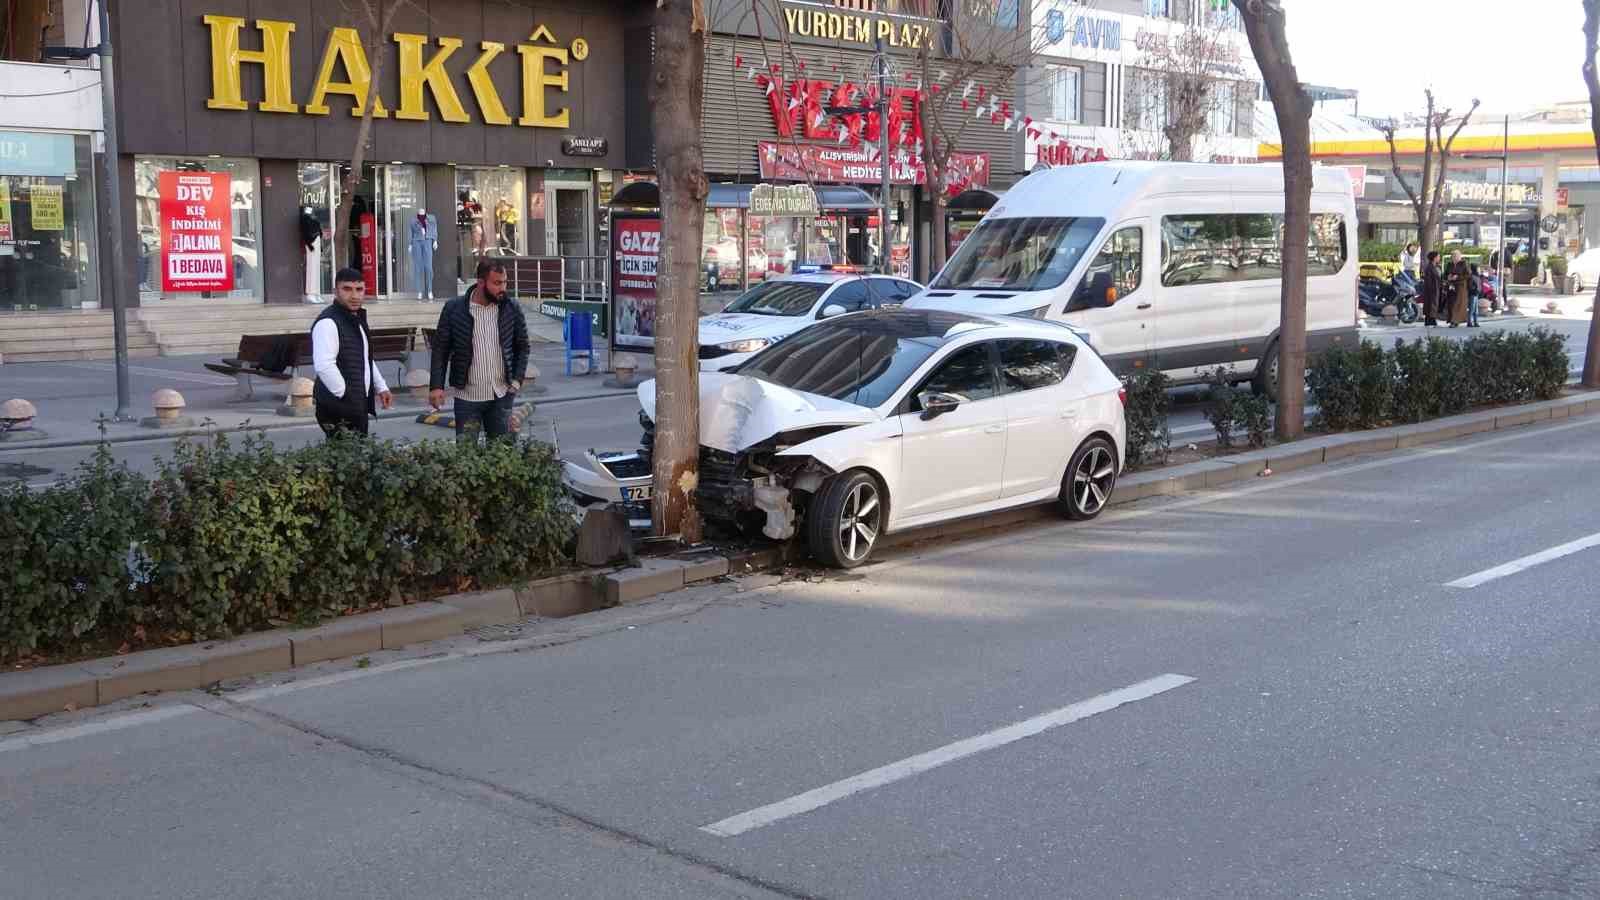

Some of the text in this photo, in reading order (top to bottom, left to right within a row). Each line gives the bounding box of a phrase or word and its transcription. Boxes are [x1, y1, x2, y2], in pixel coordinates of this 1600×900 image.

[784, 8, 870, 43] YURDEM
[1072, 15, 1121, 50] AVM
[176, 185, 214, 201] DEV
[186, 205, 206, 218] KIŞ
[171, 217, 221, 231] İNDİRİMİ
[183, 234, 221, 250] ALANA
[172, 259, 223, 274] 1 BEDAVA
